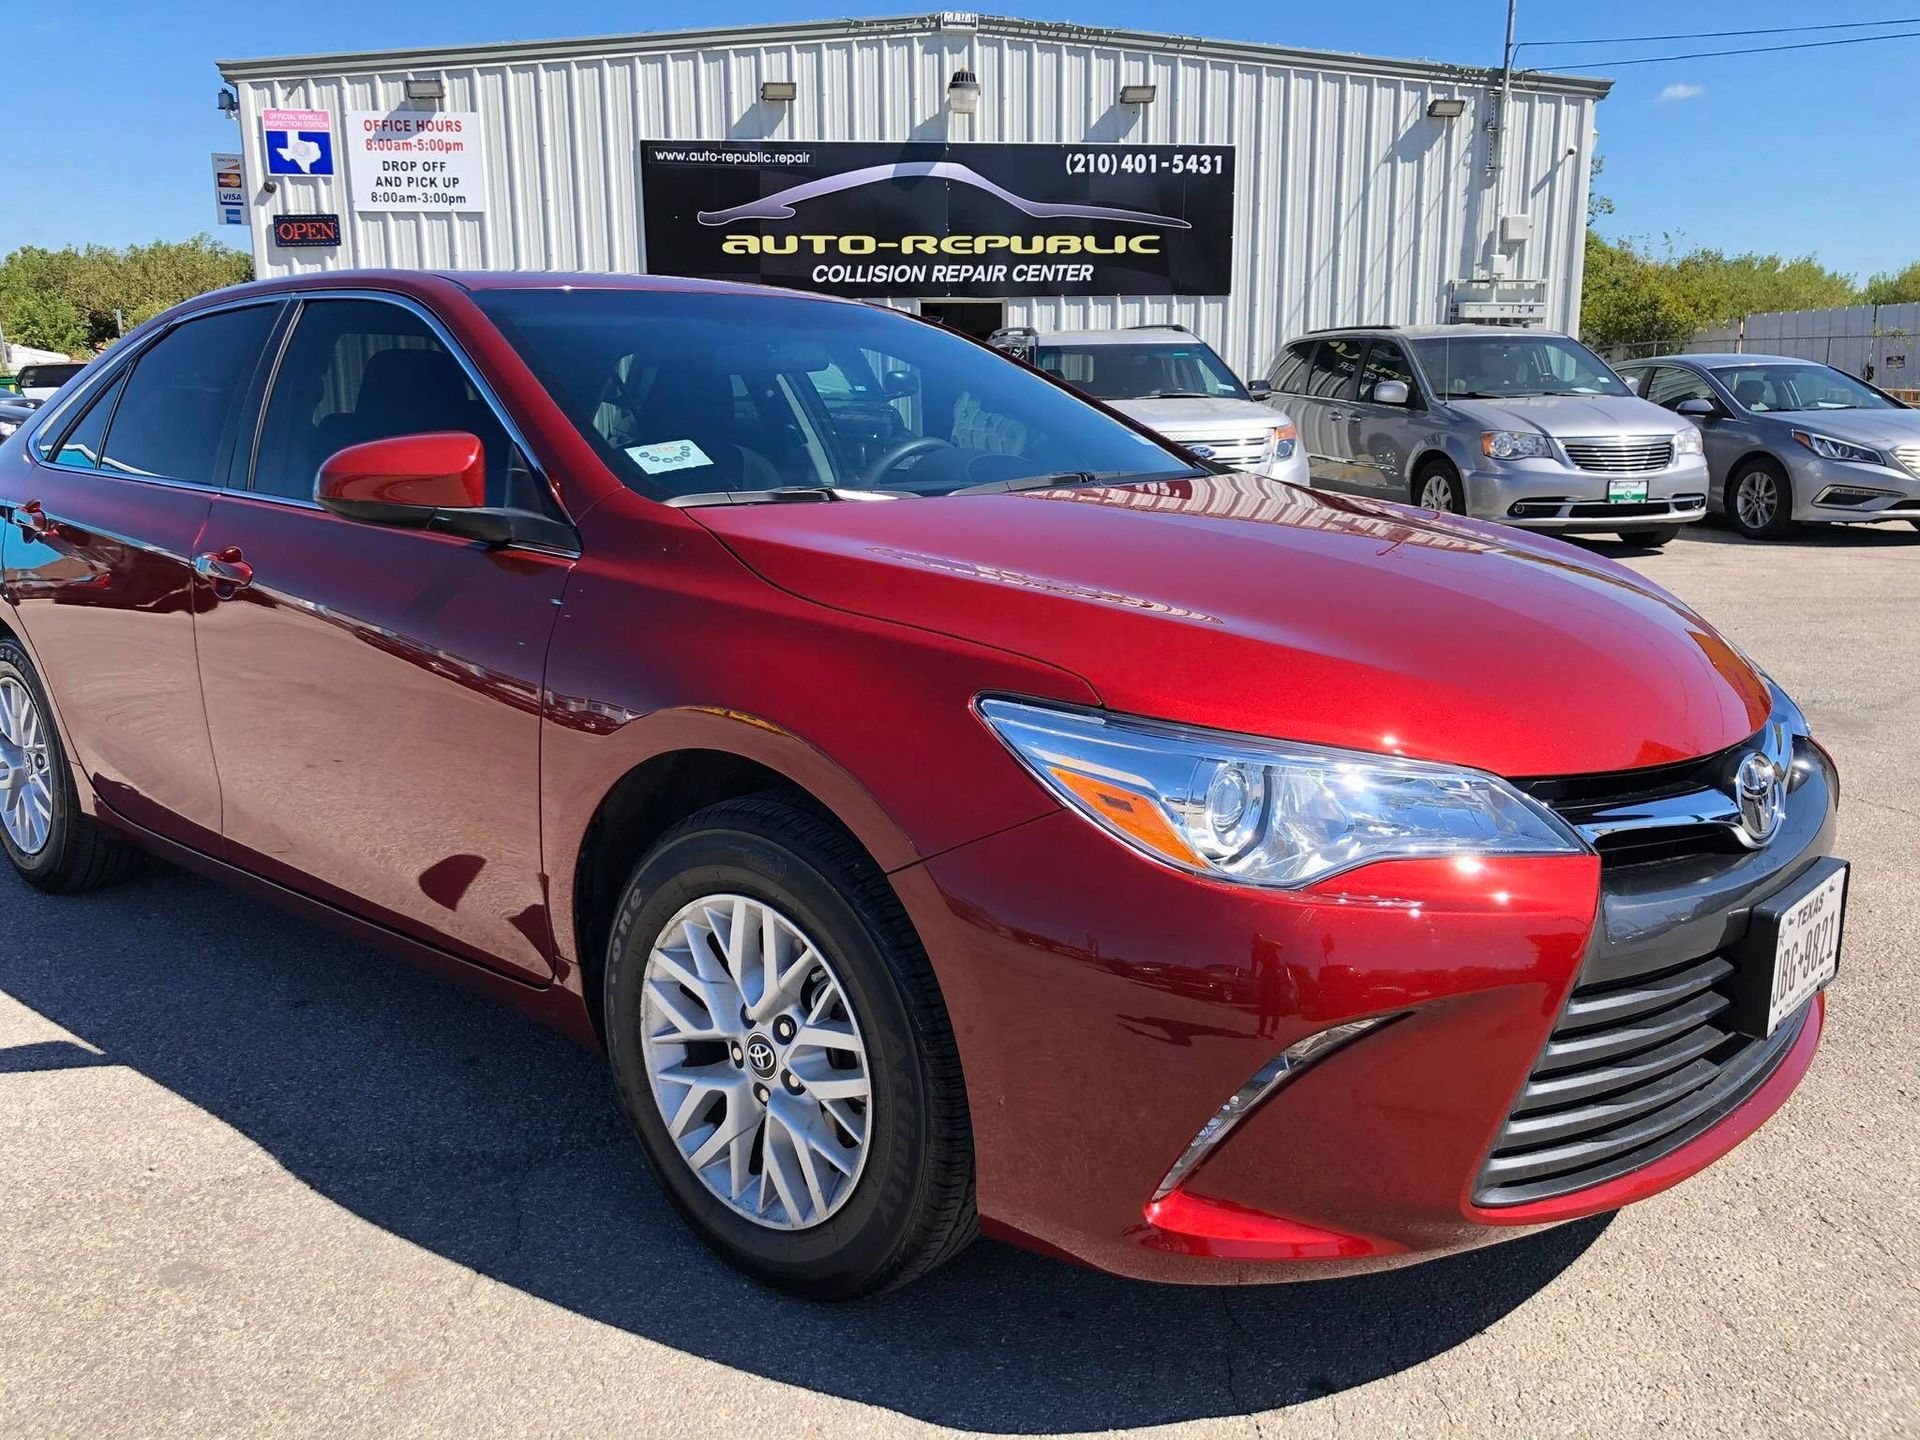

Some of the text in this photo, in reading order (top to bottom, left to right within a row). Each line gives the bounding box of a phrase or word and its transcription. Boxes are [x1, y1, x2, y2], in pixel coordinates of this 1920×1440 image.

[363, 119, 462, 132] OFFICE HOURS
[365, 139, 464, 154] 8:00am-5:00pm
[655, 150, 810, 165] www.auto-republic.repair
[382, 160, 447, 172] DROP OFF
[375, 176, 460, 188] AND PICK UP
[223, 193, 242, 201] VISA
[370, 191, 466, 206] 8:00am-3:00pm
[279, 222, 335, 240] OPEN
[812, 263, 1095, 283] COLLISION REPAIR CENTER
[1796, 891, 1826, 929] TEXAS
